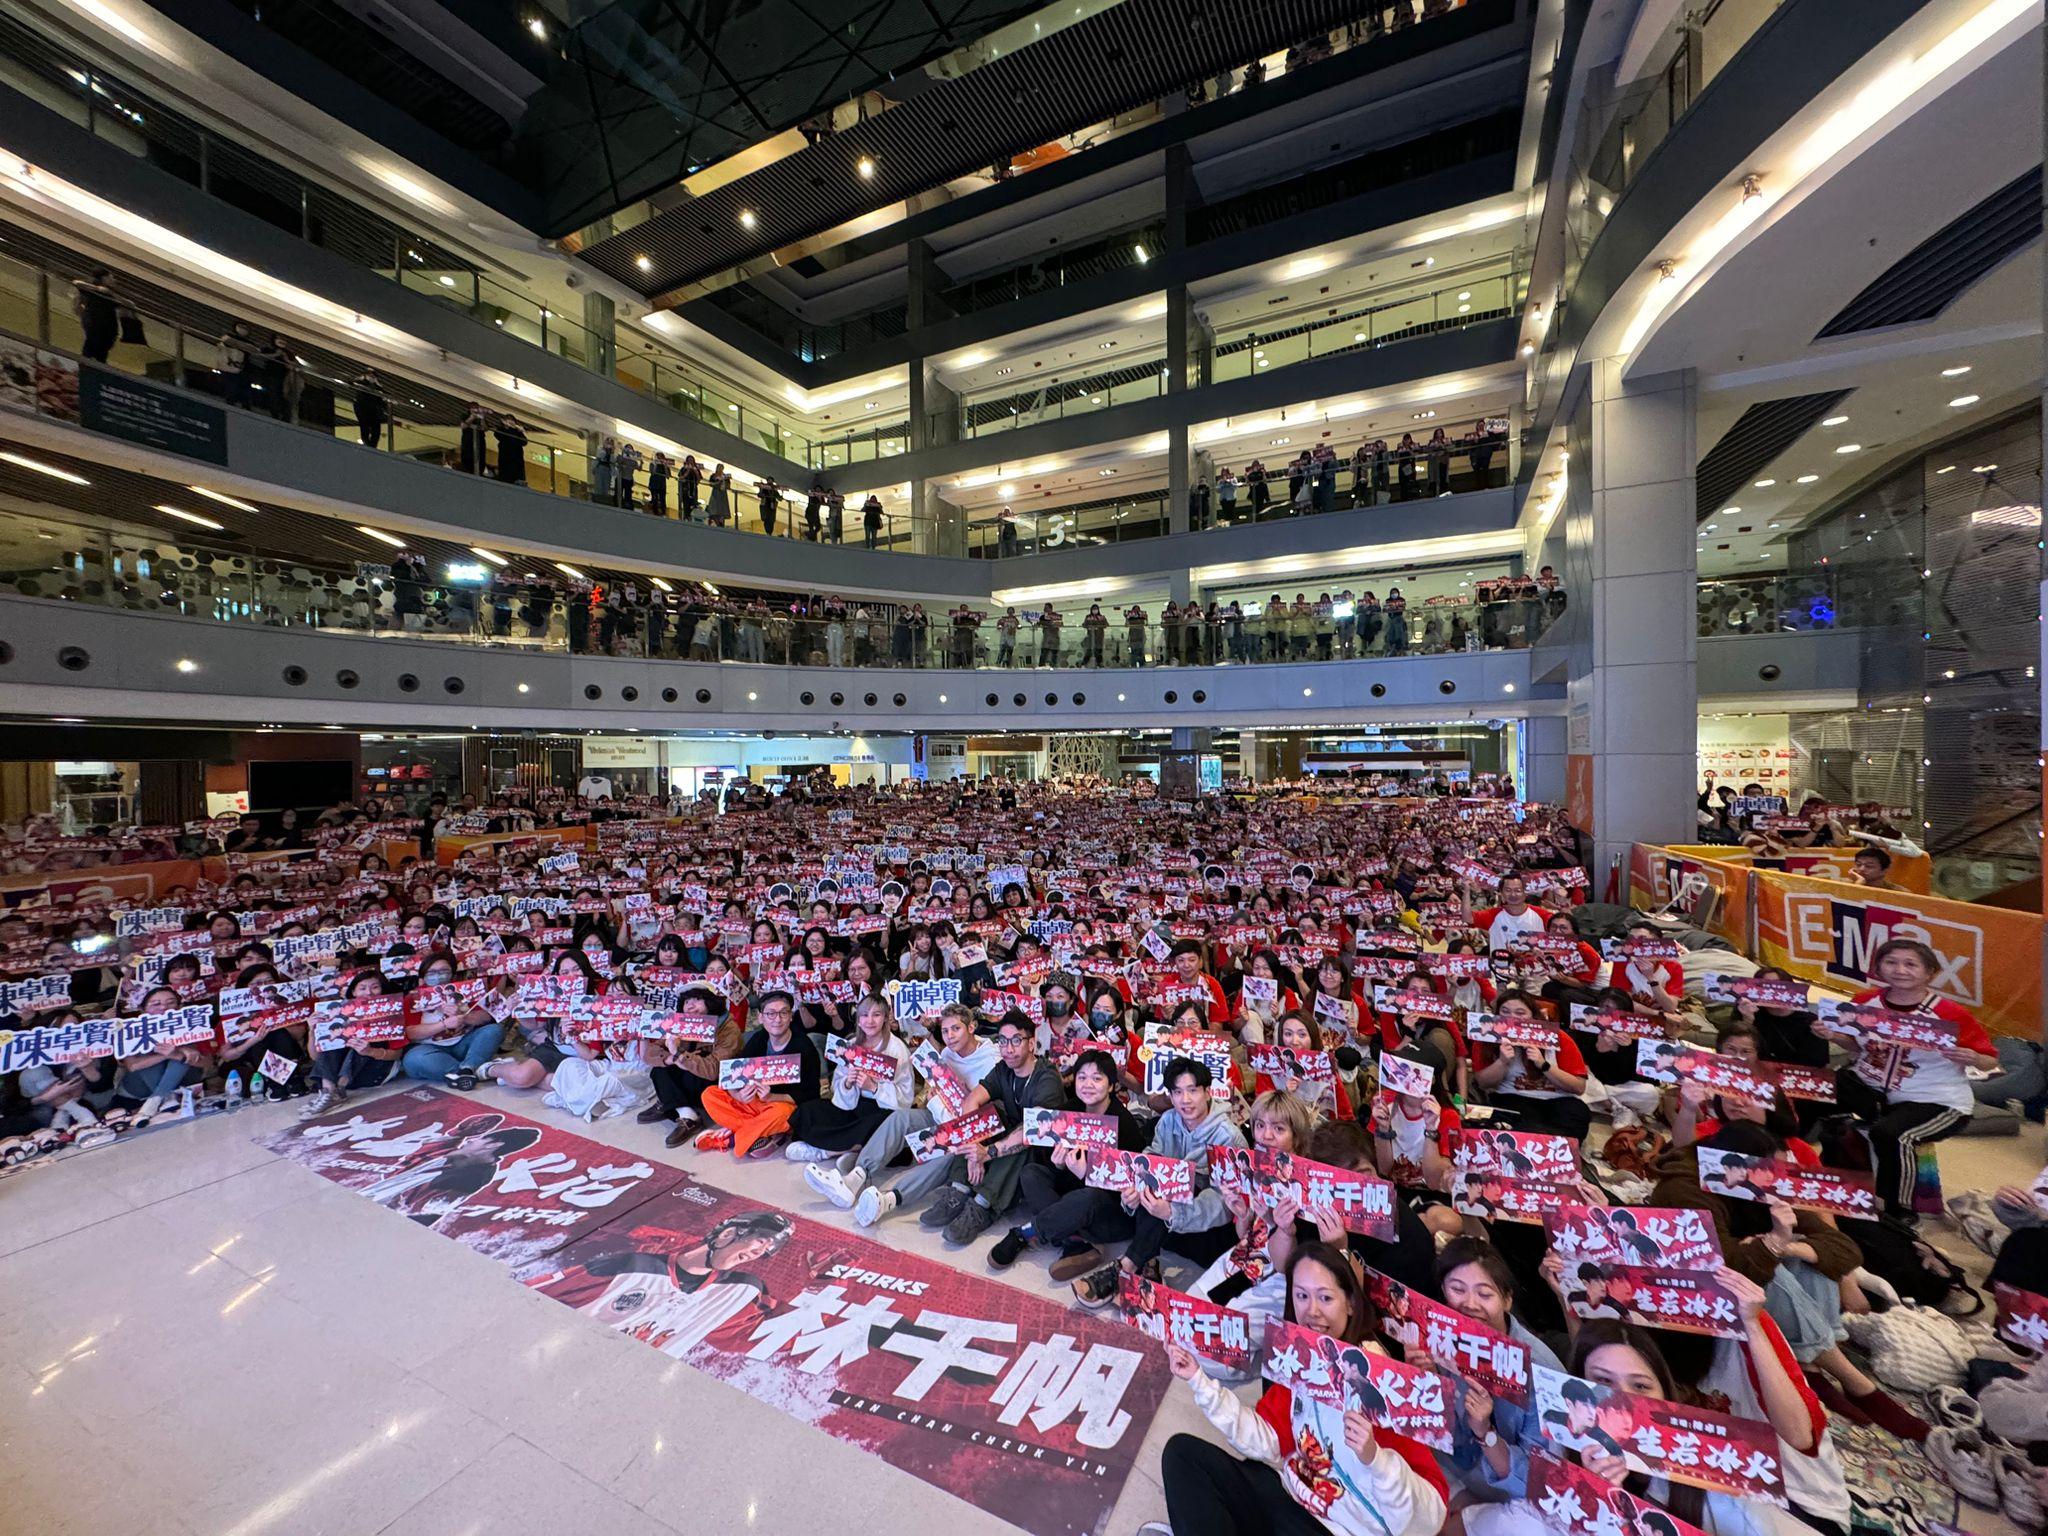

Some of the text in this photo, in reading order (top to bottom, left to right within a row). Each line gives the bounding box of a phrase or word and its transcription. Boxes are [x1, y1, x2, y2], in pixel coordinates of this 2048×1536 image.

[1047, 515, 1065, 546] 3
[117, 908, 184, 937] 陳卓賢
[507, 952, 543, 971] 林千帆
[1352, 961, 1380, 976] 冰上
[1449, 957, 1490, 974] 林千帆
[896, 978, 960, 1019] 陳卓賢
[1166, 987, 1206, 1004] 林千帆
[1405, 999, 1451, 1015] 生若冰火
[1745, 986, 1807, 1008] 生若冰火
[353, 1000, 403, 1017] 生若冰火
[117, 1006, 213, 1058] 陳卓賢
[354, 1023, 405, 1038] 生若冰火
[670, 1020, 715, 1036] 生若冰火
[1506, 1027, 1559, 1044] 生若冰火
[1610, 1019, 1665, 1038] 生若冰火
[1875, 1020, 1958, 1050] 生若冰火
[2, 1021, 114, 1071] 陳卓賢
[1181, 1038, 1231, 1052] 生若冰火
[753, 1063, 800, 1081] 生若冰火
[853, 1056, 896, 1078] 生若冰火
[1250, 1052, 1331, 1070] 冰上 火花
[1690, 1063, 1776, 1101] 生若冰火
[1780, 1074, 1835, 1096] 若冰火
[948, 1115, 1000, 1145] 生若冰火
[1066, 1126, 1116, 1144] 生若冰火
[1453, 1136, 1574, 1168] 冰上 火花
[1091, 1160, 1190, 1184] 冰上 火花
[1308, 1169, 1334, 1180] SPARKS
[1308, 1178, 1392, 1216] 林千帆
[1771, 1175, 1875, 1209] 生若冰火
[1552, 1208, 1710, 1252] 冰上 火花
[825, 1262, 930, 1298] SPARKS
[1169, 1298, 1193, 1310] SPARKS
[1632, 1287, 1738, 1324] 生若冰火
[1169, 1308, 1249, 1351] 林千帆
[1427, 1321, 1528, 1387] 林千帆
[745, 1284, 1144, 1450] 林千帆
[1267, 1343, 1333, 1386] 冰上
[1376, 1368, 1446, 1415] 火花
[1307, 1387, 1341, 1401] SPARKS
[843, 1396, 1108, 1477] IAN CHAN CHEUK YIN
